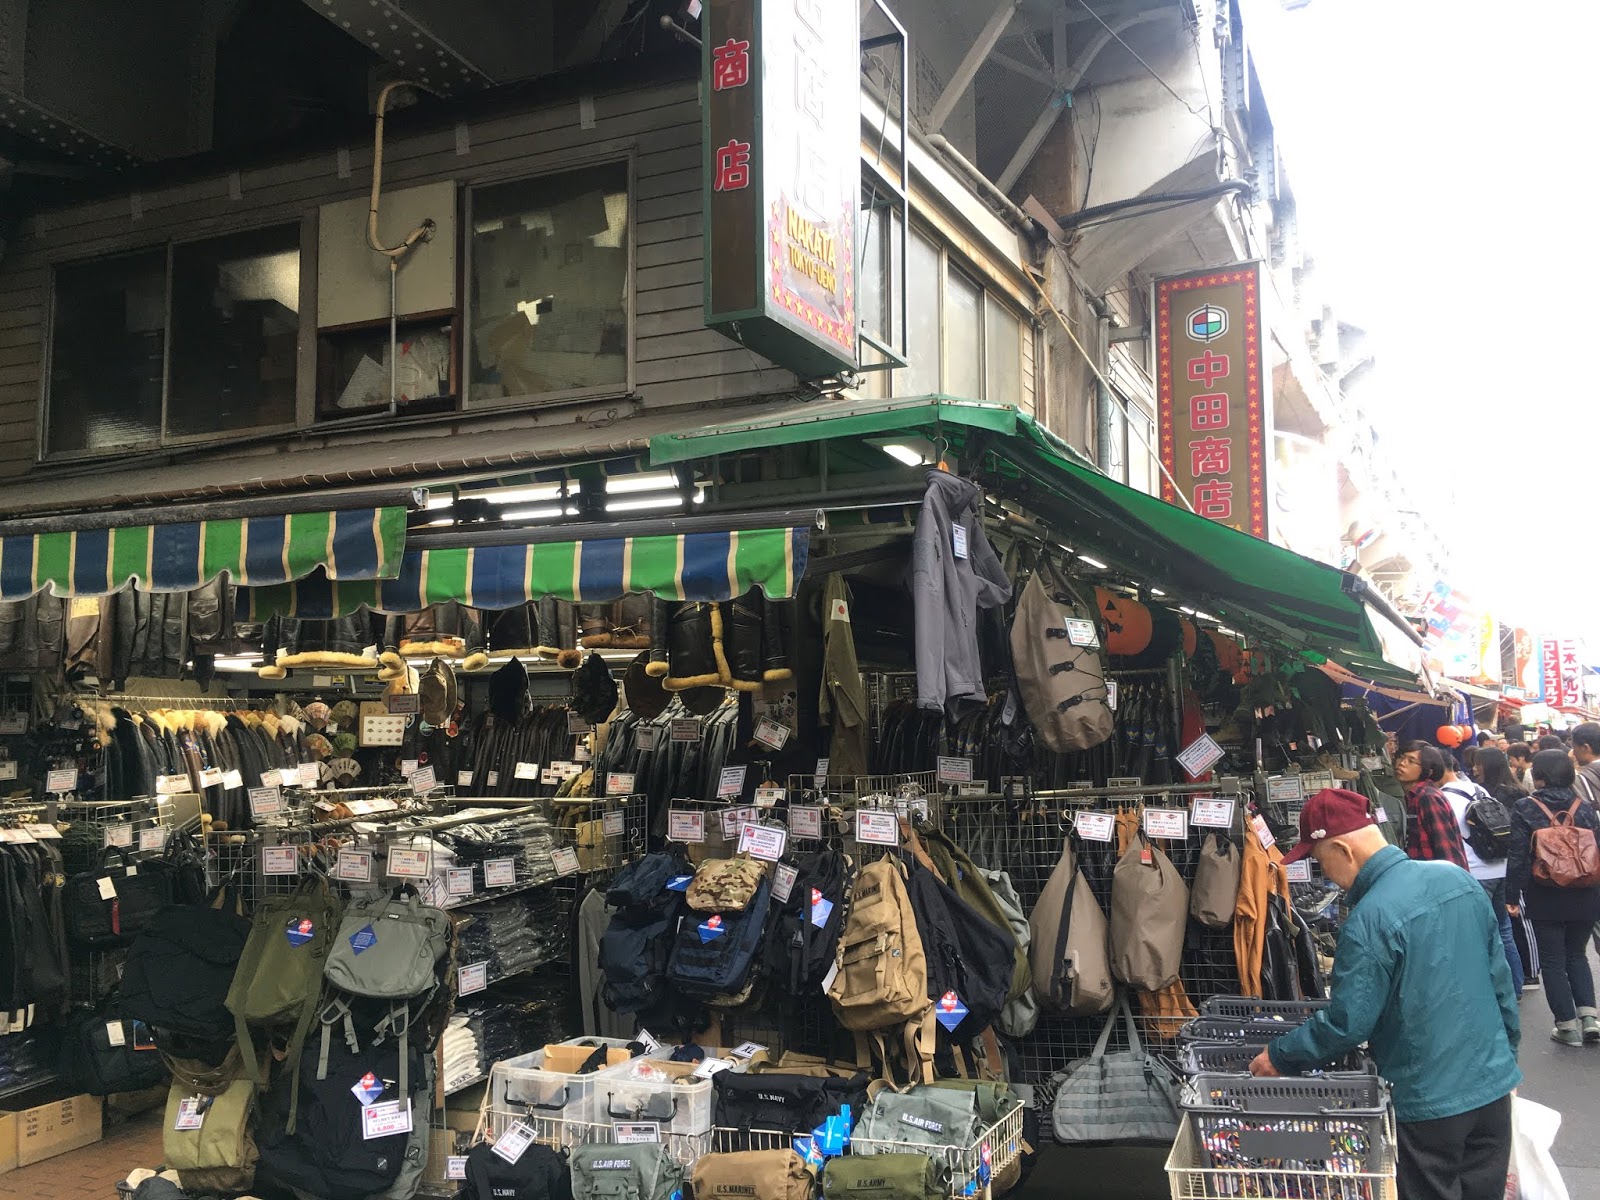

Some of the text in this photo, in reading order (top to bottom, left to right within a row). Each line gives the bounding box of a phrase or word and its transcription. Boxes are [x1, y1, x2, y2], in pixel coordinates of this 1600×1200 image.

[712, 38, 750, 192] 商店
[786, 206, 836, 270] NAKATA
[788, 243, 837, 295] TOKYO-UENO
[1186, 350, 1232, 519] 中田商店
[741, 1045, 756, 1055] XL
[707, 1064, 715, 1073] L
[925, 1119, 943, 1132] FORCE
[613, 1159, 631, 1168] FORCE
[716, 1185, 755, 1195] U.S.MARINES
